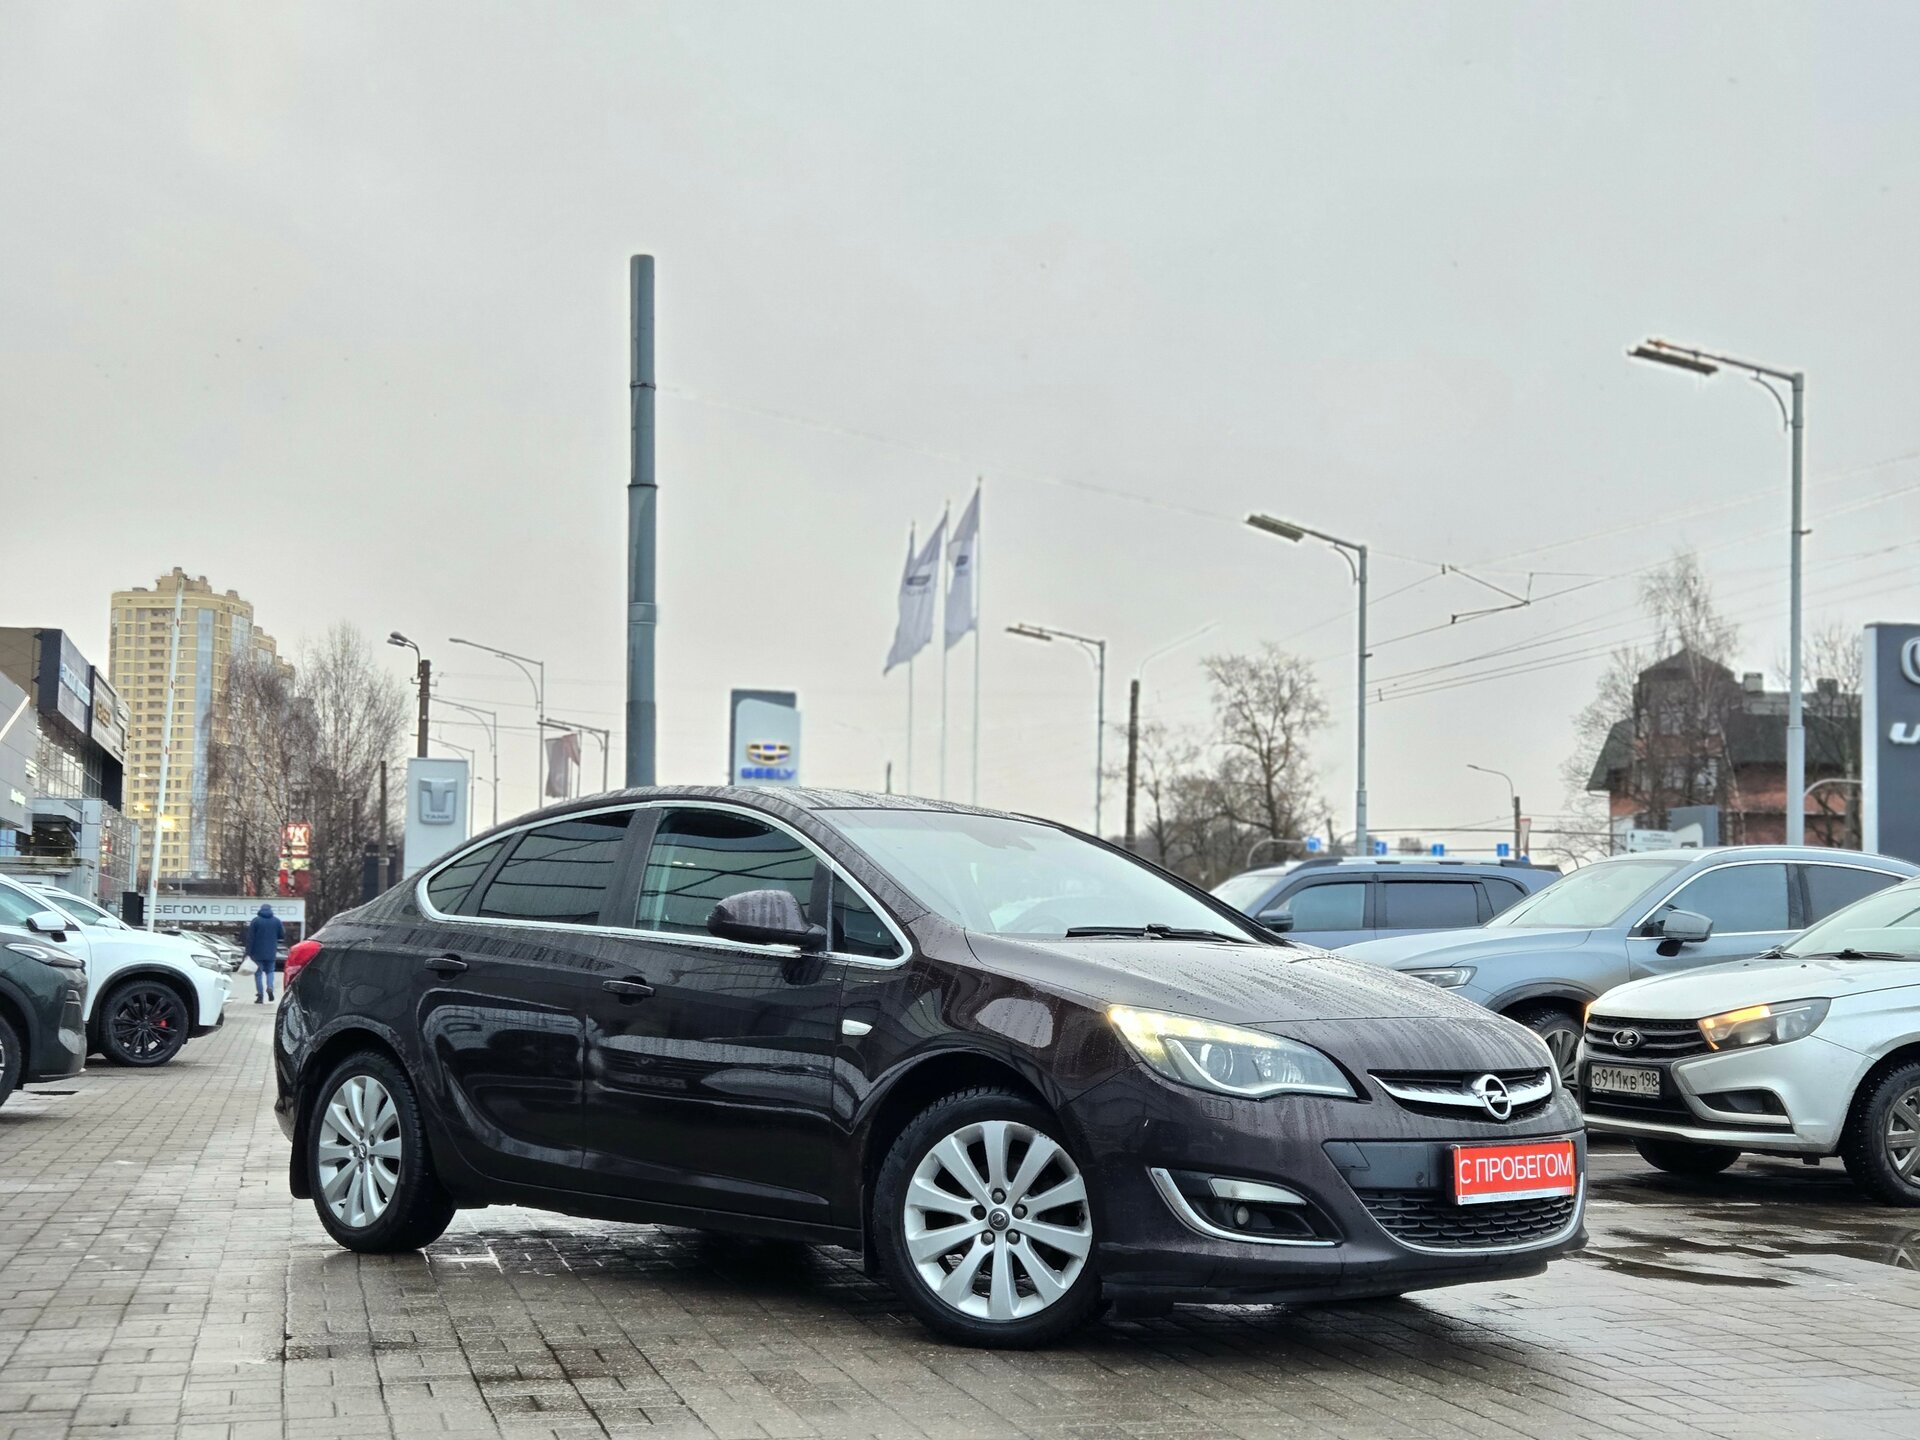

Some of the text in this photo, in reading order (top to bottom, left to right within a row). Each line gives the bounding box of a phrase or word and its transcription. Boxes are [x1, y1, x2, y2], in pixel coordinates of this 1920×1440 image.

[1640, 1072, 1658, 1087] 198
[1460, 1153, 1572, 1184] С ПРОБЕГОМ
